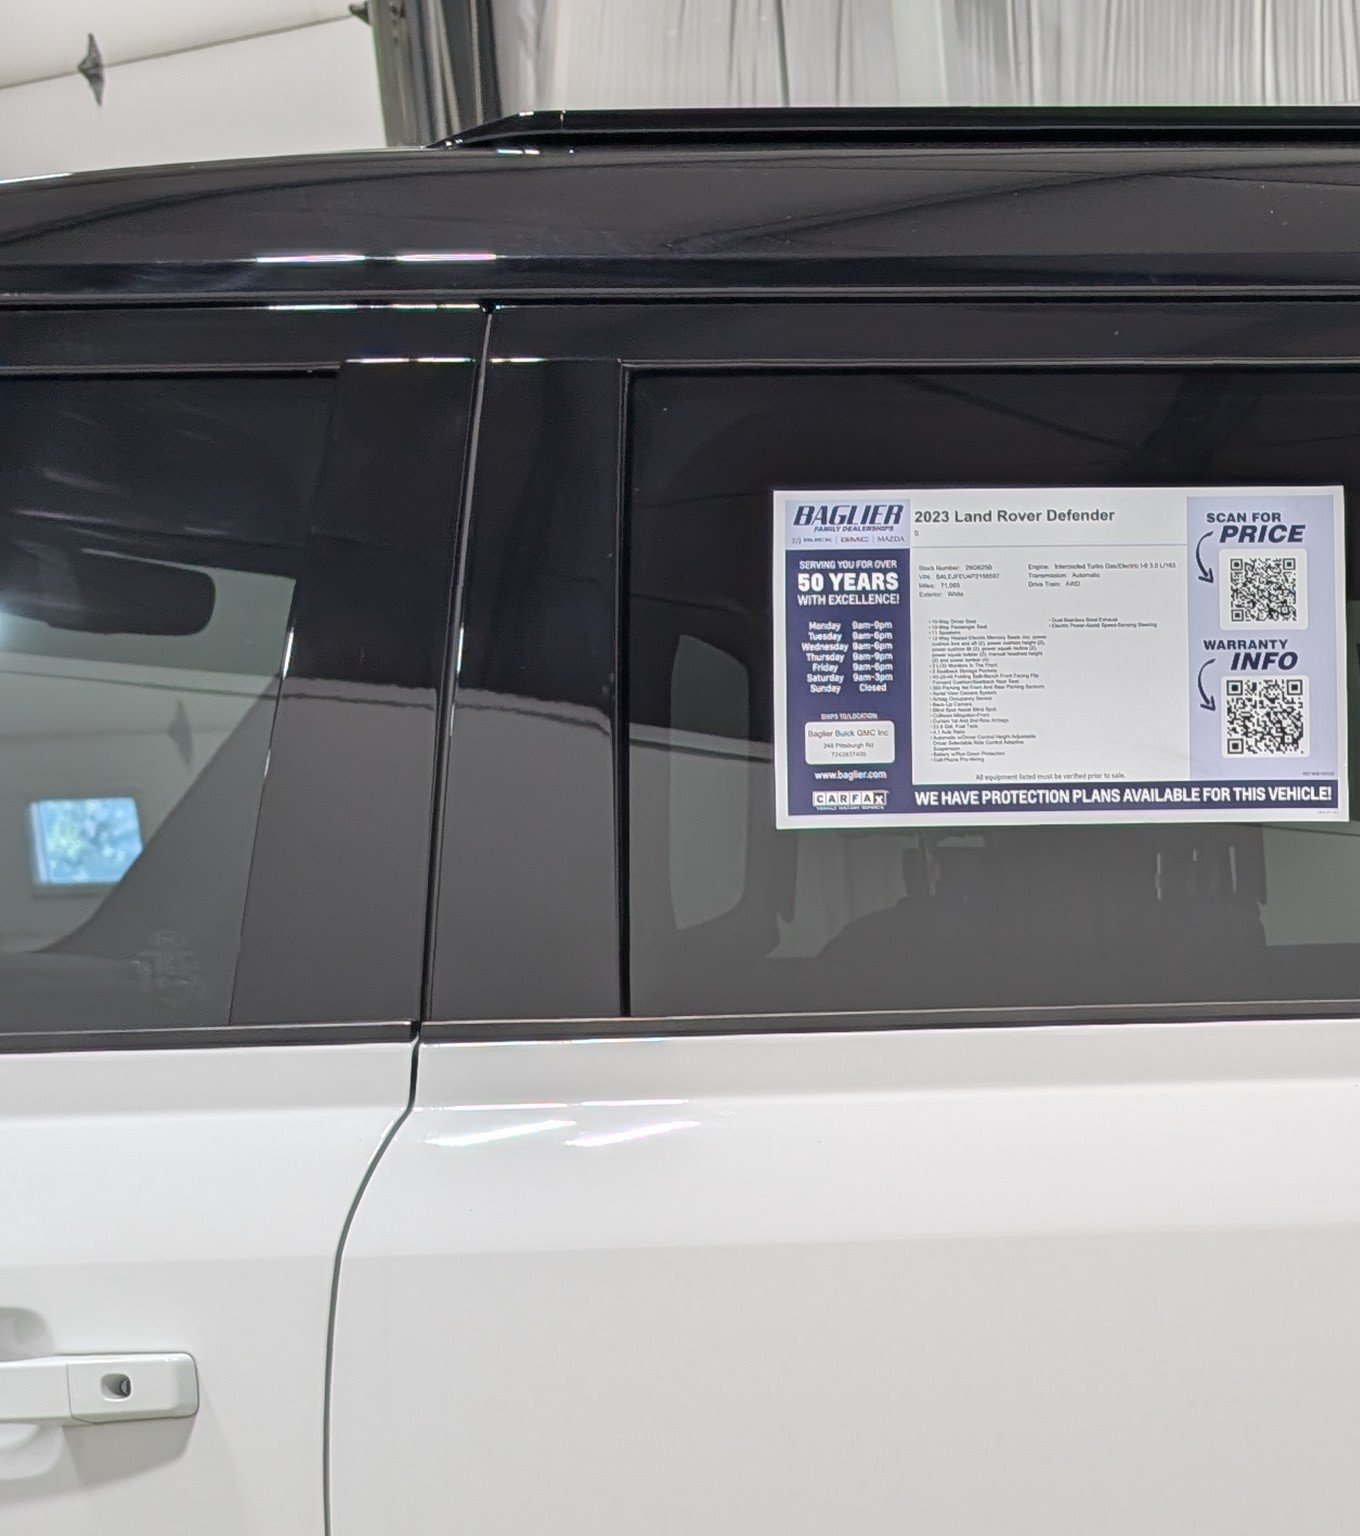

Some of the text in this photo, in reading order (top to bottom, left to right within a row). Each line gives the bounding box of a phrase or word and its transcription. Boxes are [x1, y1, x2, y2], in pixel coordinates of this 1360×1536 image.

[793, 505, 904, 525] BAGLIER
[914, 509, 1115, 523] 2023 Land Rover Defender
[1206, 512, 1282, 523] SCAN FOR
[1219, 525, 1306, 543] PRICE
[799, 559, 898, 570] SERVING YOU FOR OVER
[797, 572, 899, 592] 50 YEARS
[797, 593, 900, 606] WITH EXCELLENCE!
[809, 621, 841, 632] Monday
[808, 631, 842, 642] Tuesday
[801, 642, 849, 652] Wednesday
[1203, 639, 1288, 650] WARRANTY
[806, 652, 845, 663] Thursday
[1231, 652, 1298, 670] INFO
[812, 663, 838, 673] Friday
[807, 673, 844, 684] Saturday
[810, 683, 887, 694] Sunday Closed
[808, 730, 833, 739] Baglier
[857, 729, 876, 737] GMC
[877, 729, 889, 737] Inc
[814, 770, 887, 781] www.baglier.com
[814, 792, 886, 805] CARFAX
[914, 786, 1332, 805] WE HAVE PROTECTION PLANS AVAILABLE FOR THIS VEHICLE!
